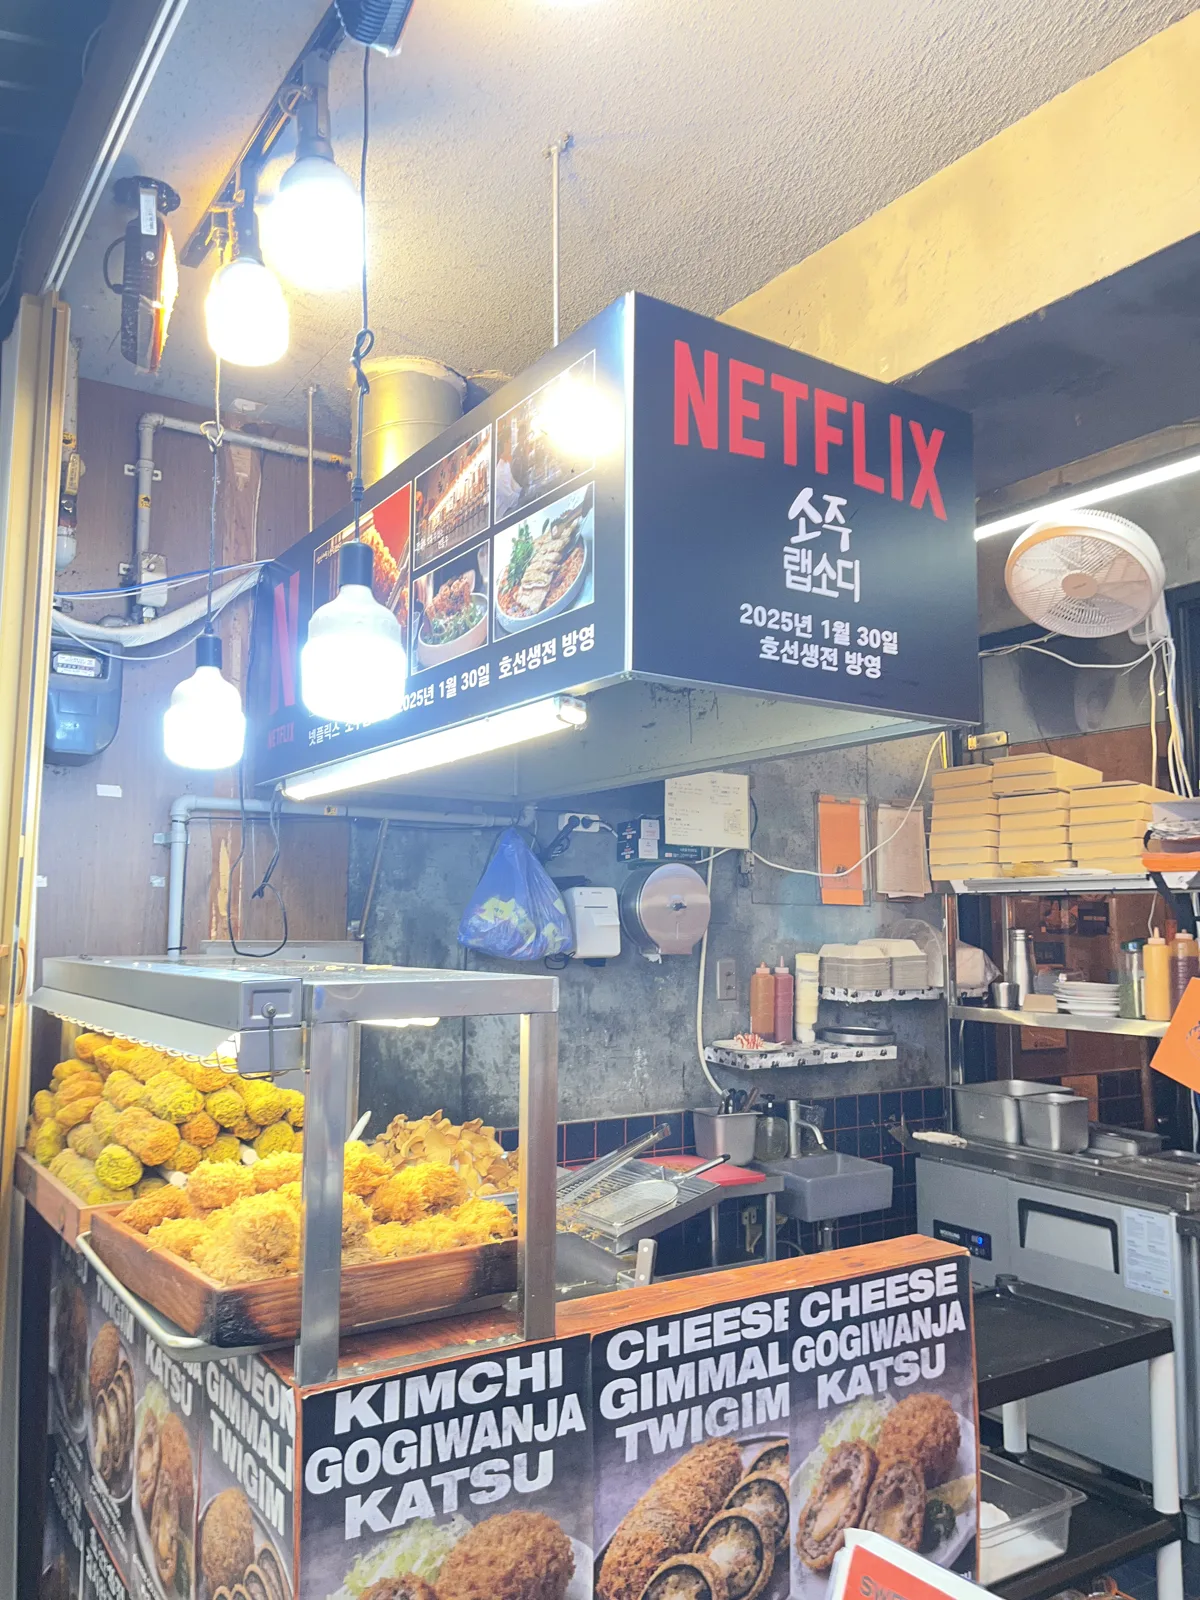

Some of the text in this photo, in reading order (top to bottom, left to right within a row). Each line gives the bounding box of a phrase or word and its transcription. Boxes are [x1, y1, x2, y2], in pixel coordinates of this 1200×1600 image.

[674, 339, 948, 521] NETFLIX
[787, 487, 853, 552] 소주
[783, 546, 860, 603] 랩소디
[439, 676, 457, 698] 1월
[460, 663, 490, 691] 30일
[498, 638, 557, 679] 호선생전
[561, 624, 595, 657] 방영
[739, 603, 899, 655] 2025년 1월 30일
[759, 636, 881, 679] 호선생전 방영
[267, 722, 294, 750] NETFLIX
[308, 722, 340, 747] 넷플릭스
[799, 1263, 959, 1328] CHEESE
[606, 1297, 789, 1371] CHEESE
[791, 1300, 966, 1373] GOGIWANJA
[145, 1333, 193, 1416] KATSU
[334, 1348, 563, 1435] KIMCHI
[817, 1343, 946, 1410] KATSU
[206, 1361, 294, 1492] GIMMALI
[304, 1393, 587, 1494] GOGIWANJA
[615, 1382, 789, 1463] TWIGIM
[210, 1409, 285, 1536] TWIGIM
[345, 1450, 554, 1540] KATSU
